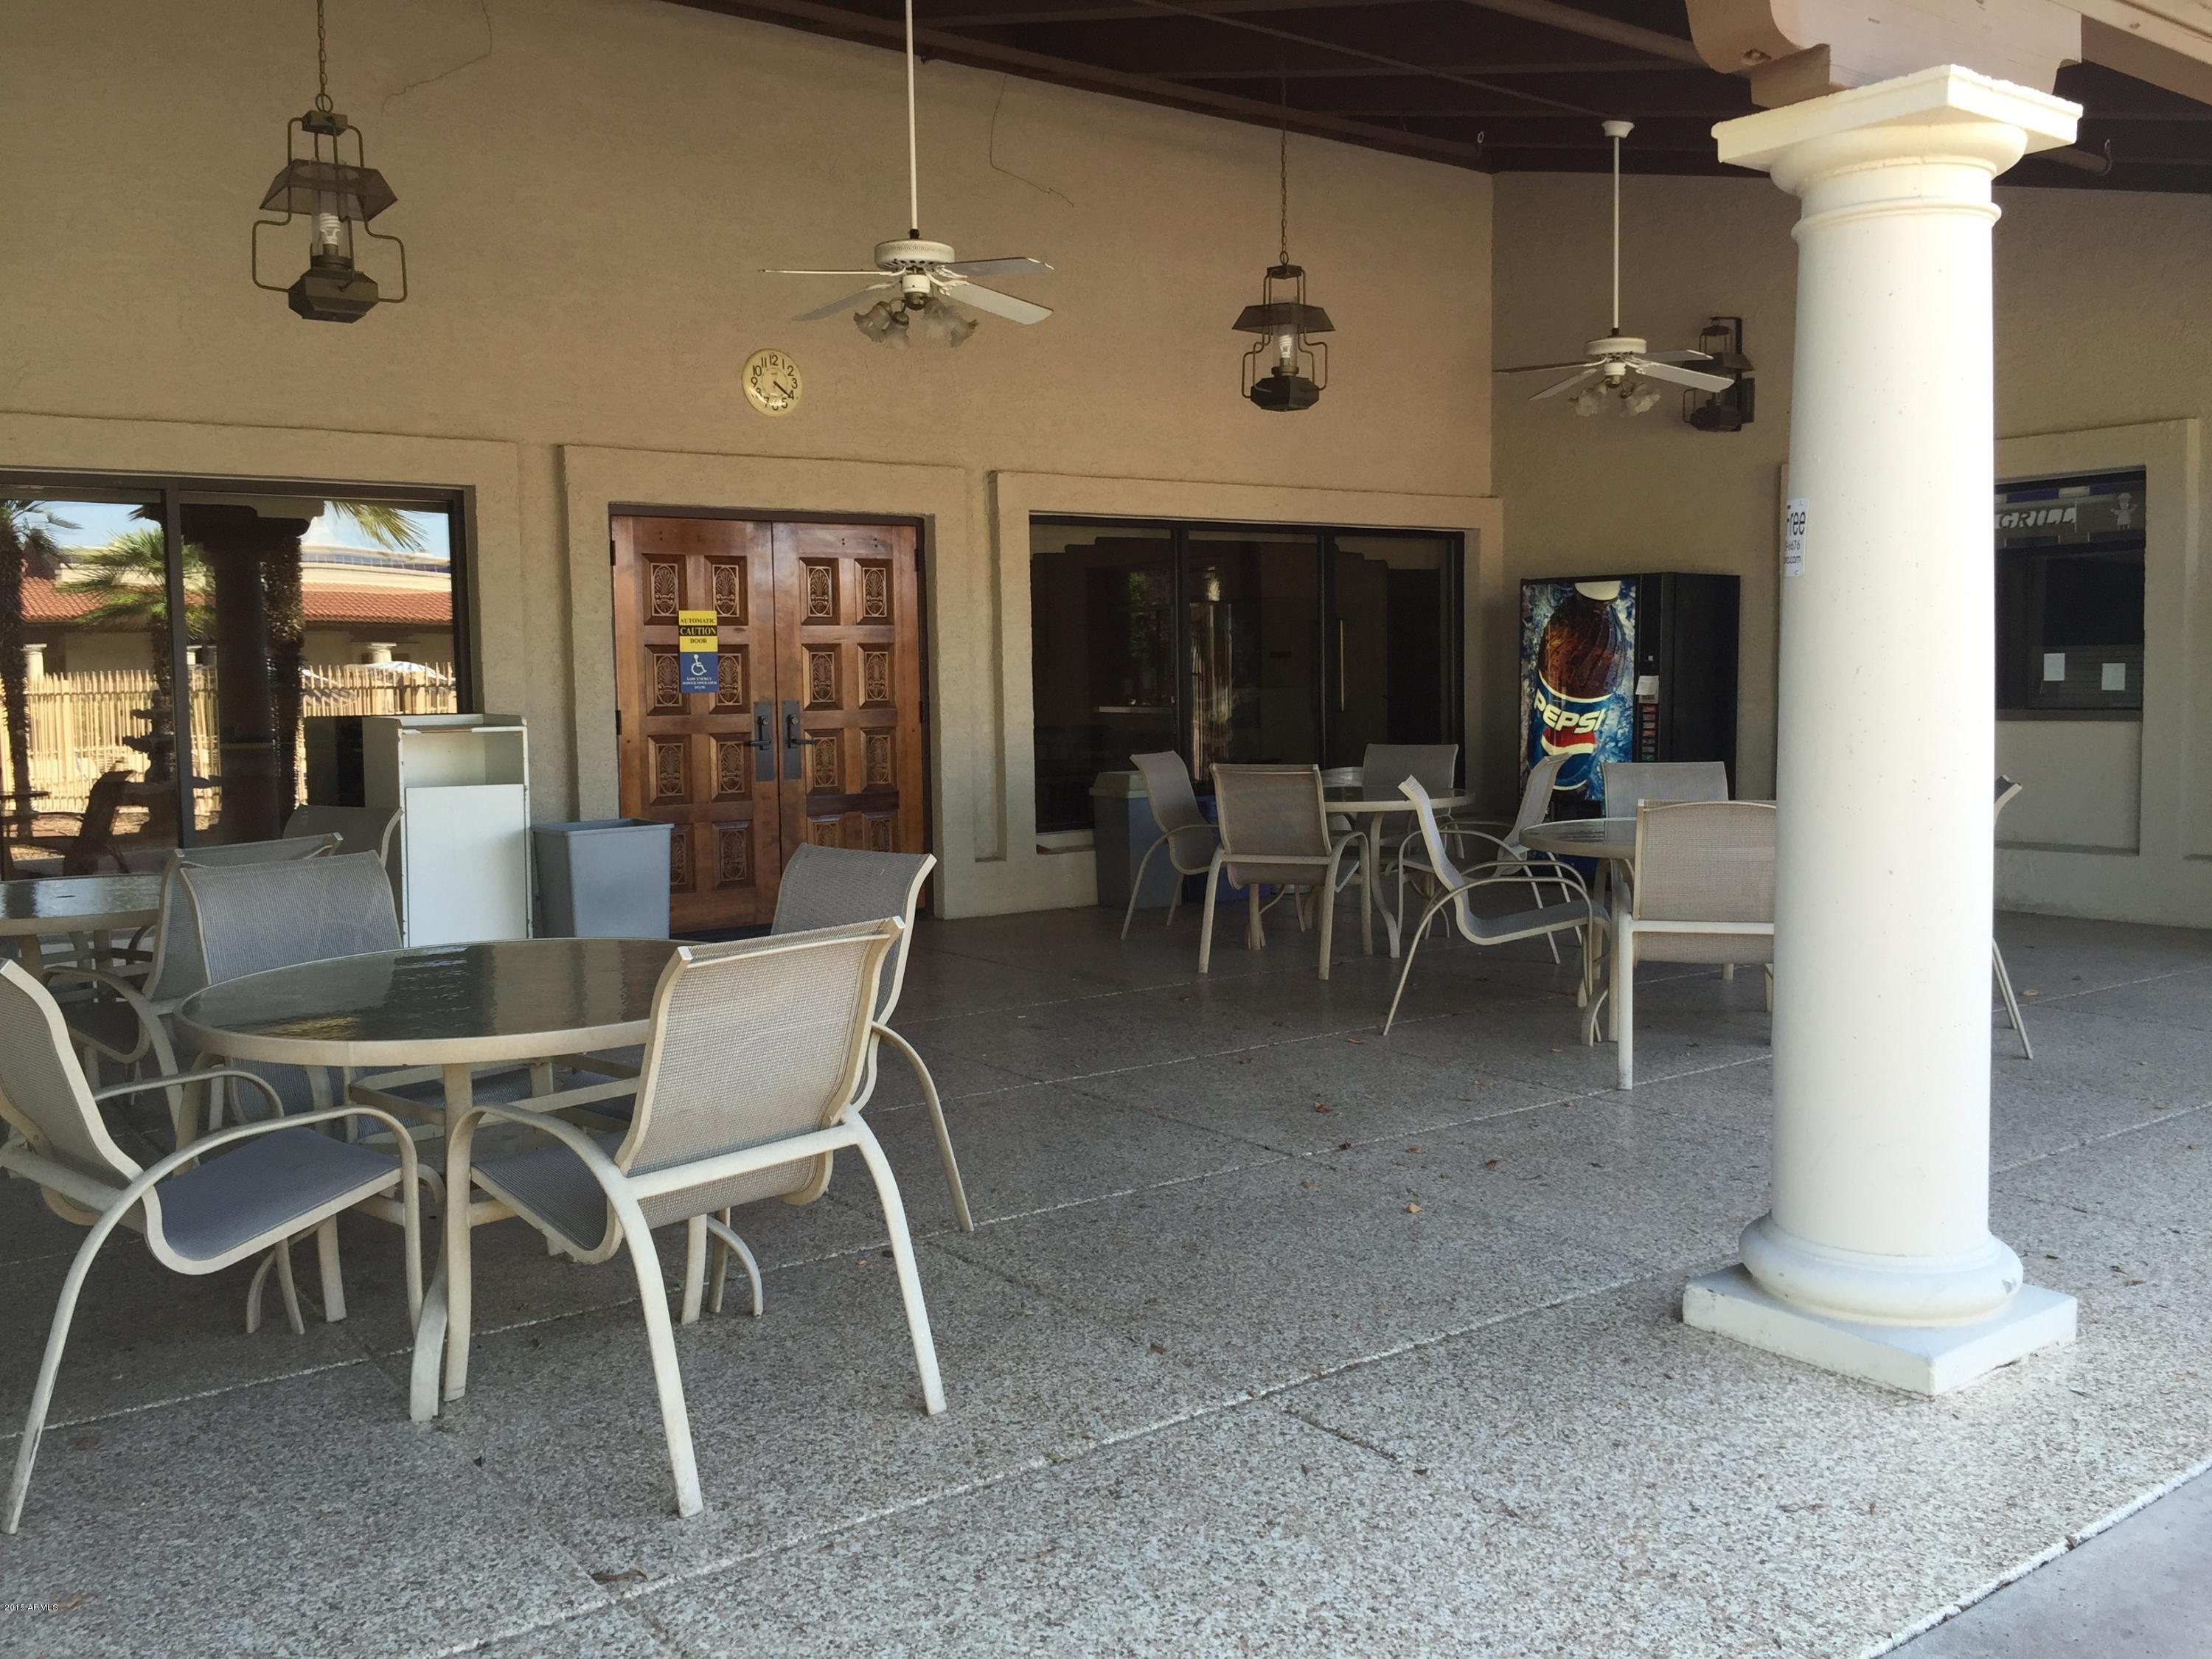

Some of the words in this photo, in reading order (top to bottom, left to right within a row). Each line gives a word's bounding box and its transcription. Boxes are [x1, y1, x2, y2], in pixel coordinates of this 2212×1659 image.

[761, 357, 768, 368] 11
[769, 354, 779, 366] 12
[753, 365, 762, 376] 10
[787, 365, 794, 377] 2
[751, 377, 758, 388] 9
[791, 378, 799, 389] 3
[781, 397, 788, 408] 5
[680, 627, 717, 636] CAUTION
[1534, 688, 1607, 734] PEPSI
